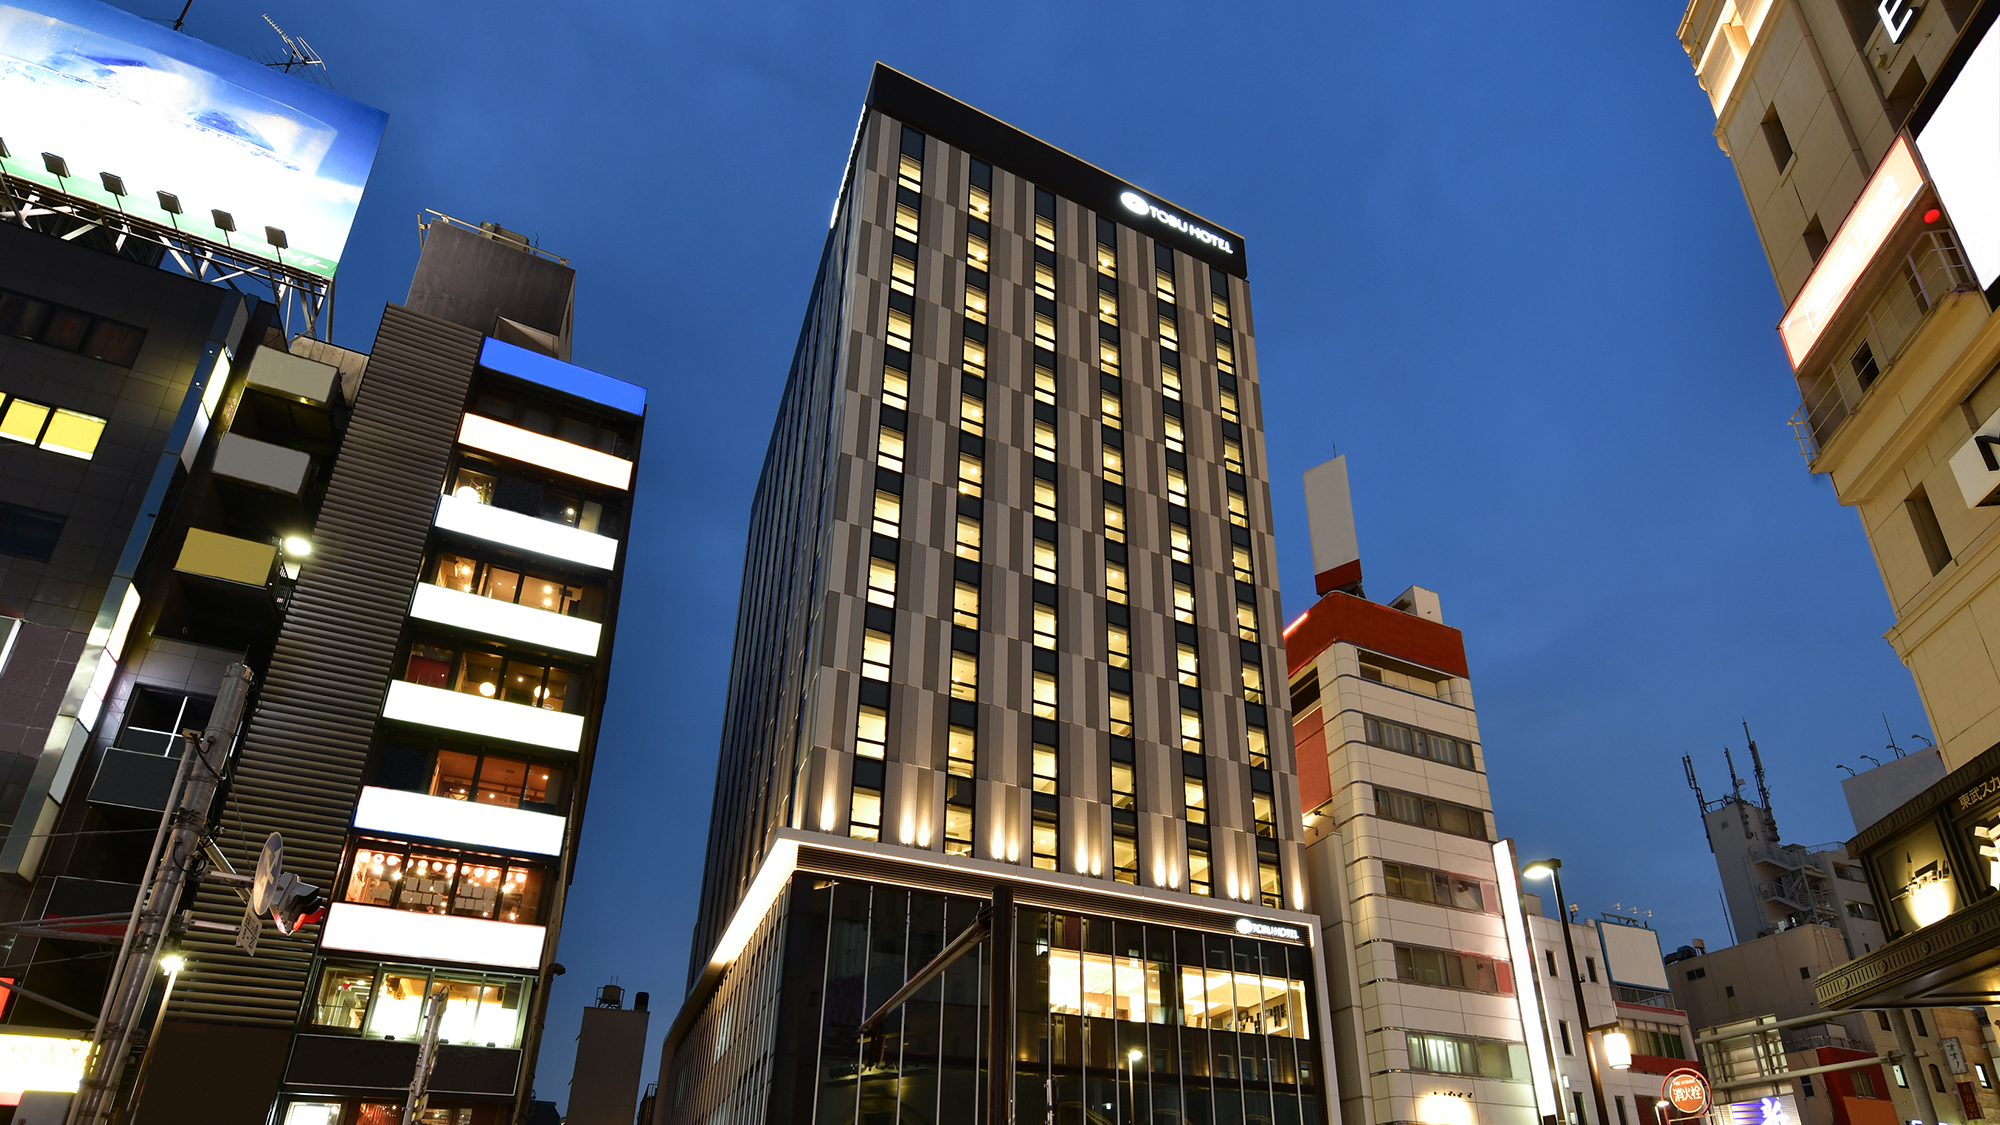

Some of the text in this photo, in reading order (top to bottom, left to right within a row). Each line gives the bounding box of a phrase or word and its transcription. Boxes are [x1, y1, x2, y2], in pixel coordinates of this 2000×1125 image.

[1149, 205, 1233, 254] TOBU HOTEL
[1251, 923, 1300, 939] TOBU HOTEL
[1672, 1085, 1702, 1102] 消火栓
